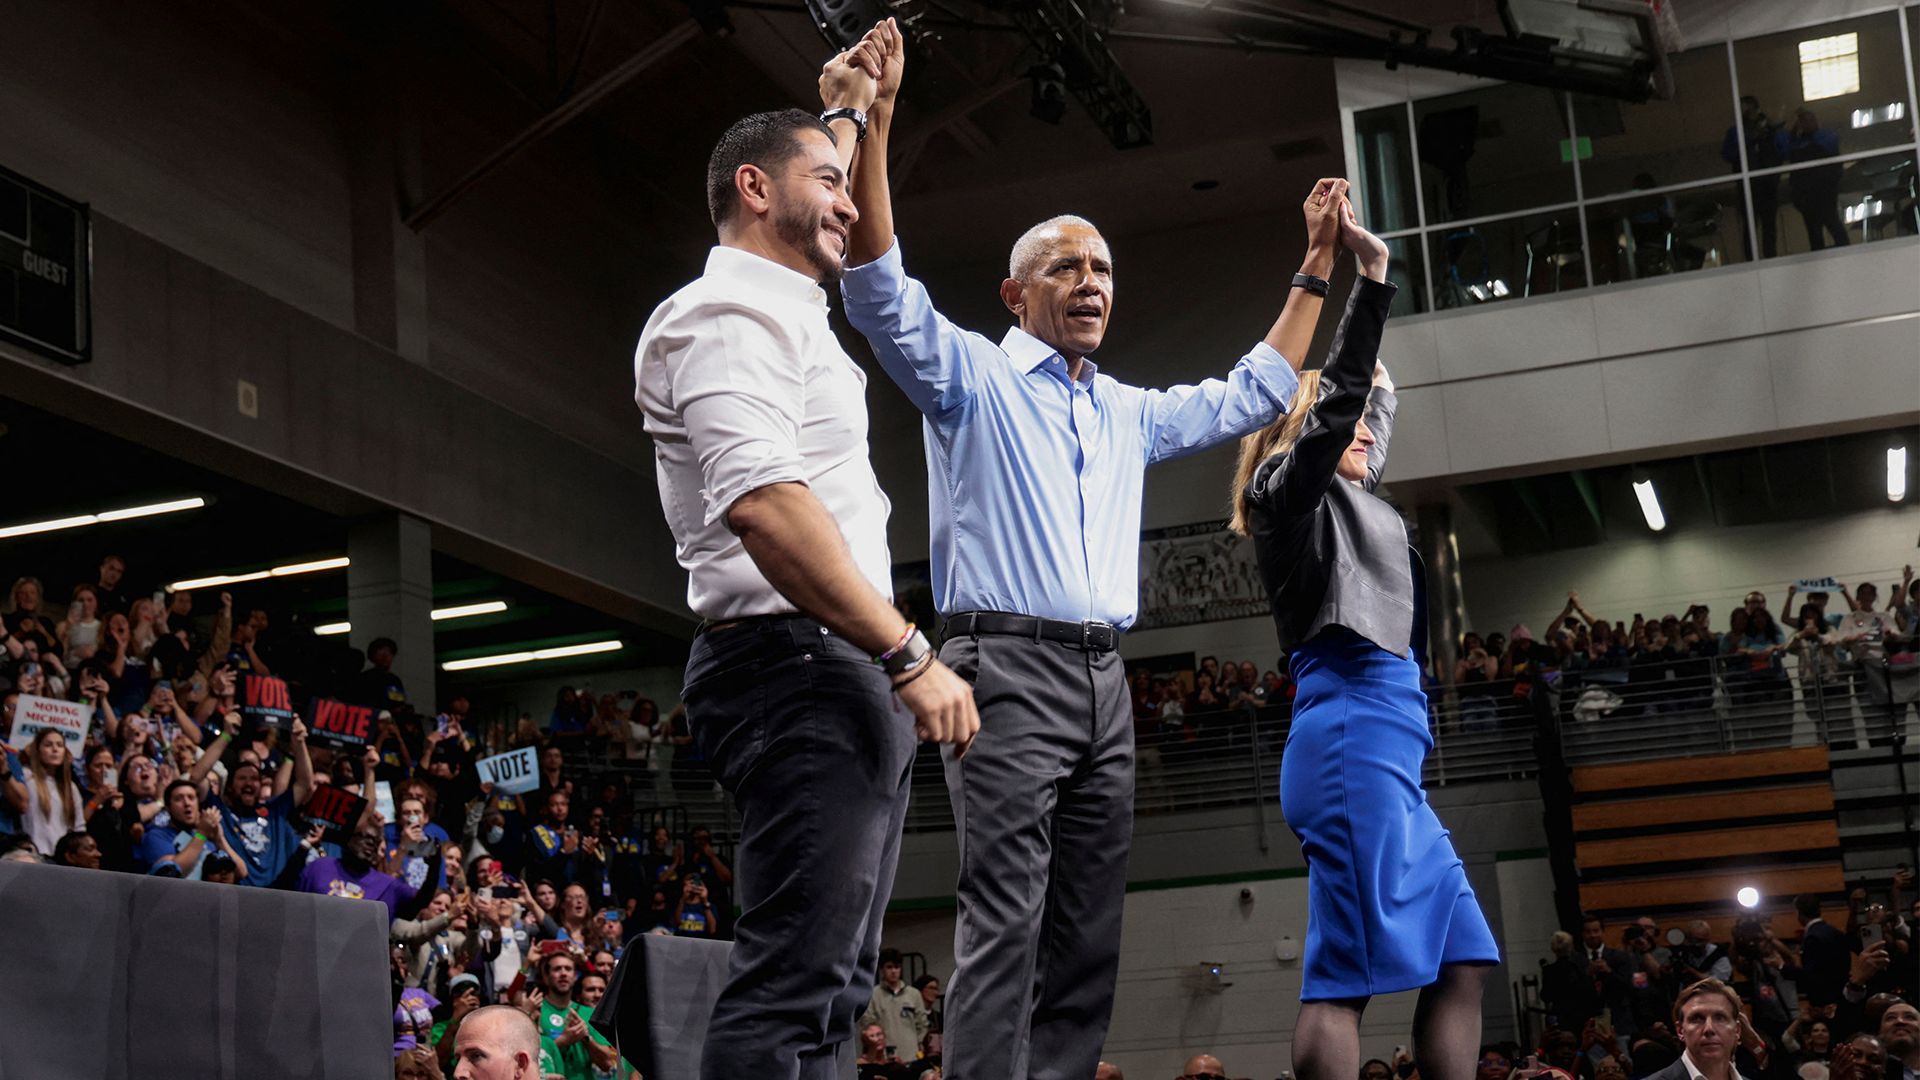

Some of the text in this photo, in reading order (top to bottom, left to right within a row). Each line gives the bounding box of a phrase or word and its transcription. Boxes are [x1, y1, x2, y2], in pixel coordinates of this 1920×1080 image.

[23, 249, 69, 287] GUEST
[34, 701, 79, 716] MOVING
[245, 674, 293, 711] VOTE
[24, 712, 81, 728] MICHIGAN
[312, 697, 373, 738] VOTE
[486, 752, 530, 782] VOTE
